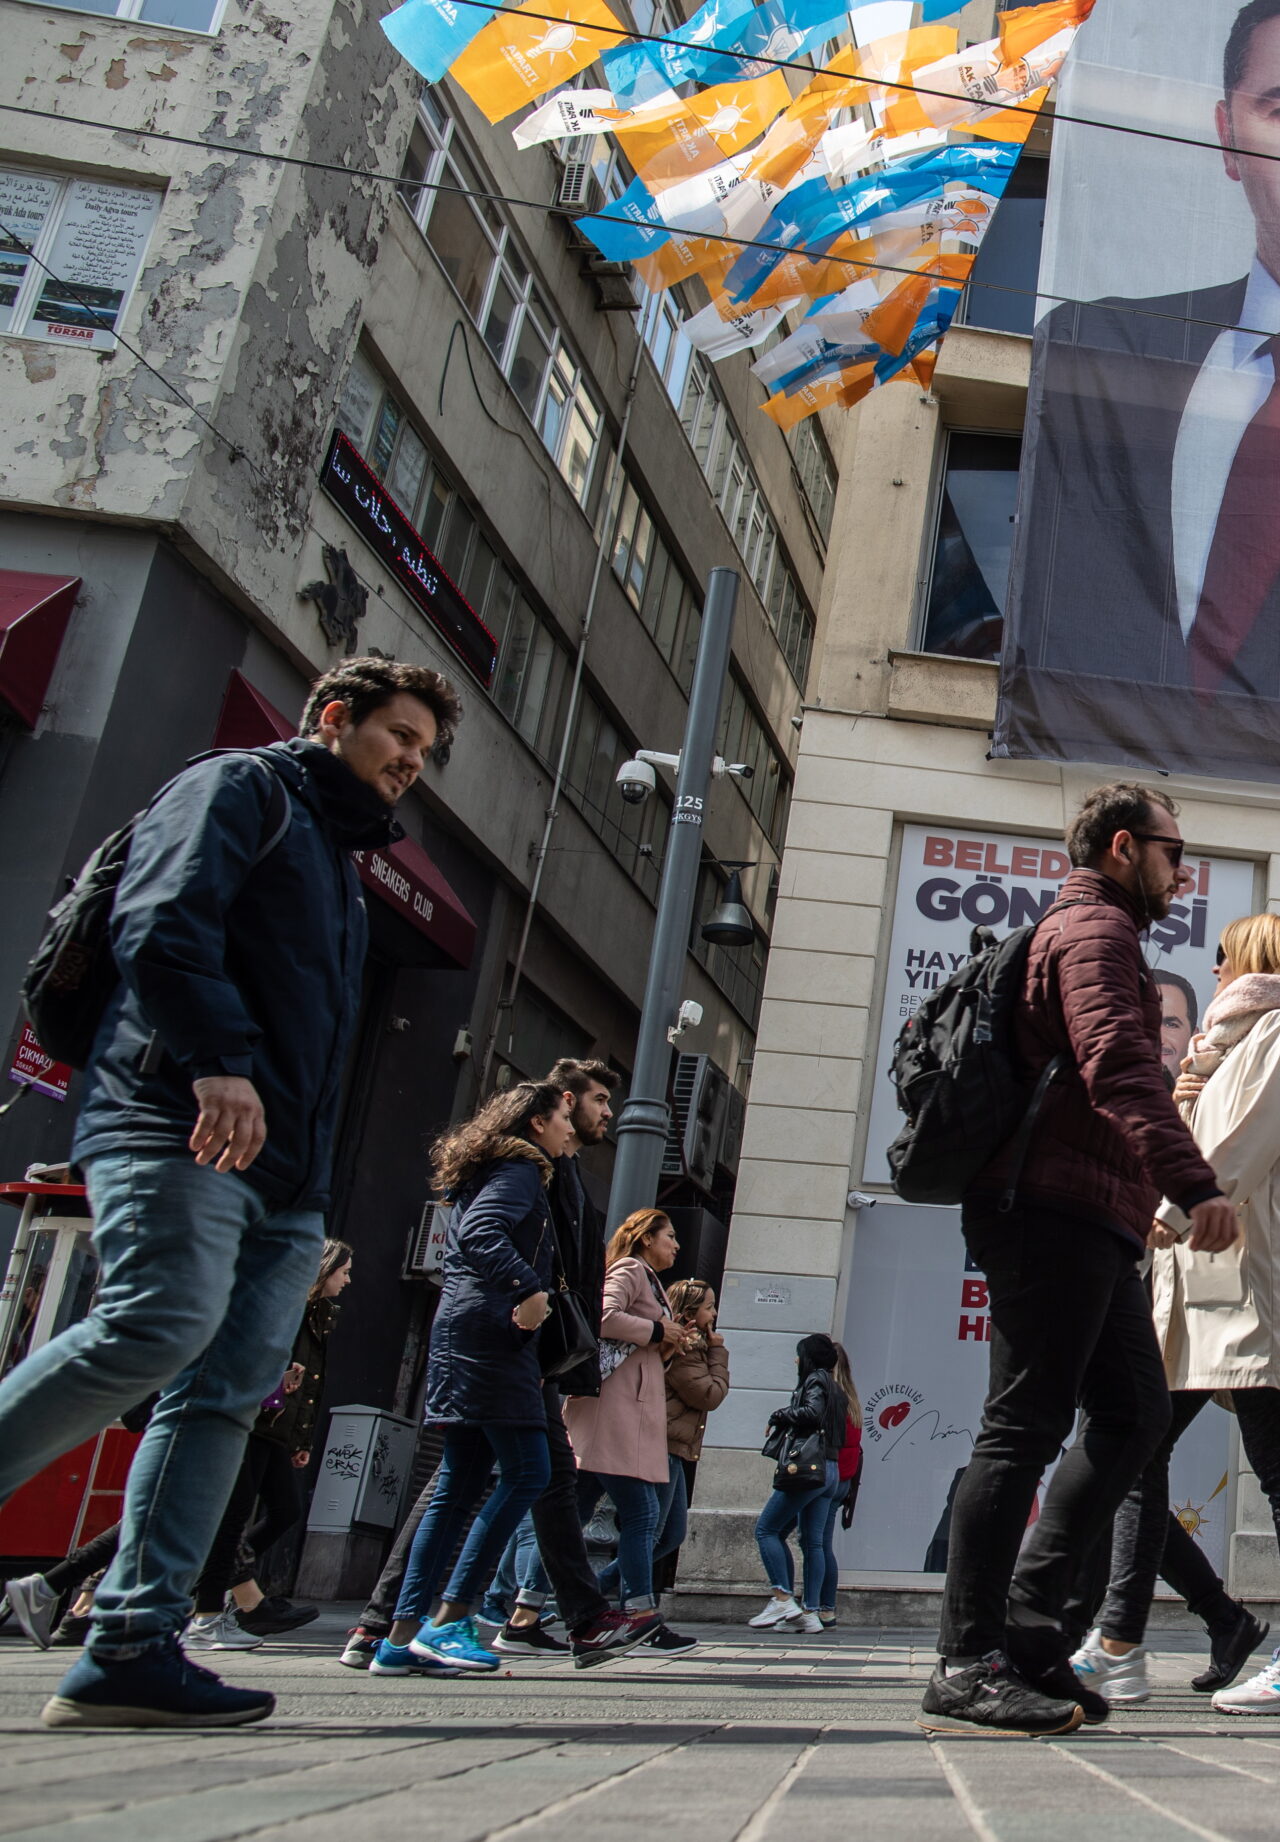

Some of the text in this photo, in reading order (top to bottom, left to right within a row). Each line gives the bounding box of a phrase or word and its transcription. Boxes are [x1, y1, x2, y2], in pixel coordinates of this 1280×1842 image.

[676, 795, 703, 810] 125
[923, 836, 1072, 879] BELED
[370, 853, 411, 903] SNEAKERS
[413, 891, 434, 922] CLUB
[916, 875, 1062, 930] GÖN
[864, 1415, 883, 1443] GÖNÜL
